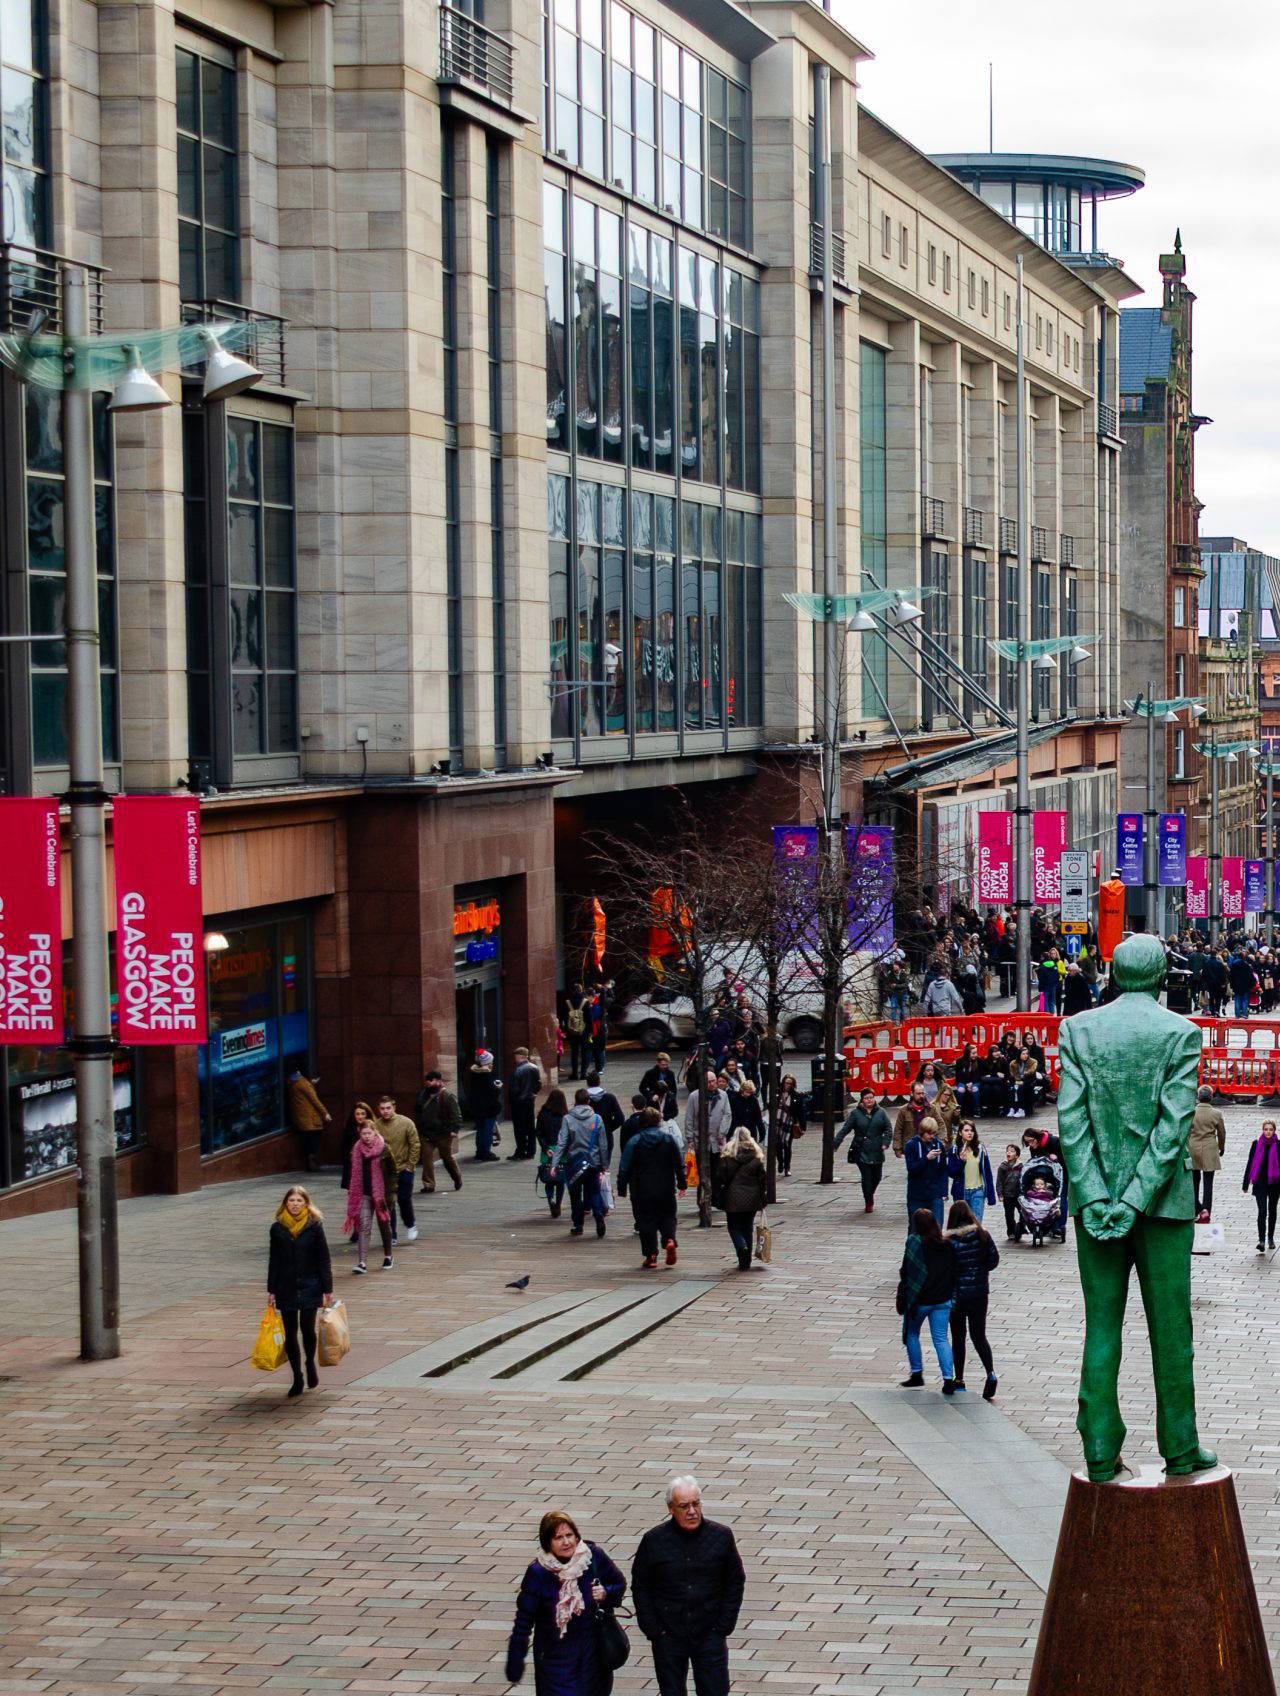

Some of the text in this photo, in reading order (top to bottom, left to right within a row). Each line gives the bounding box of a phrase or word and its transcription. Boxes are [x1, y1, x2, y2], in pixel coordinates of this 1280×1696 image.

[46, 812, 57, 887] Let's Celebrate
[187, 810, 197, 886] Let's Celebrate
[981, 846, 990, 899] GLASGOW
[990, 869, 999, 899] MAKE
[999, 861, 1009, 899] PEOPLE
[1035, 846, 1045, 899] GLASGOW
[1045, 869, 1054, 899] MAKE
[7, 954, 30, 1031] MAKE
[29, 933, 54, 1031] PEOPLE
[121, 891, 149, 1031] GLASGOW
[148, 954, 173, 1031] MAKE
[171, 932, 197, 1031] PEOPLE
